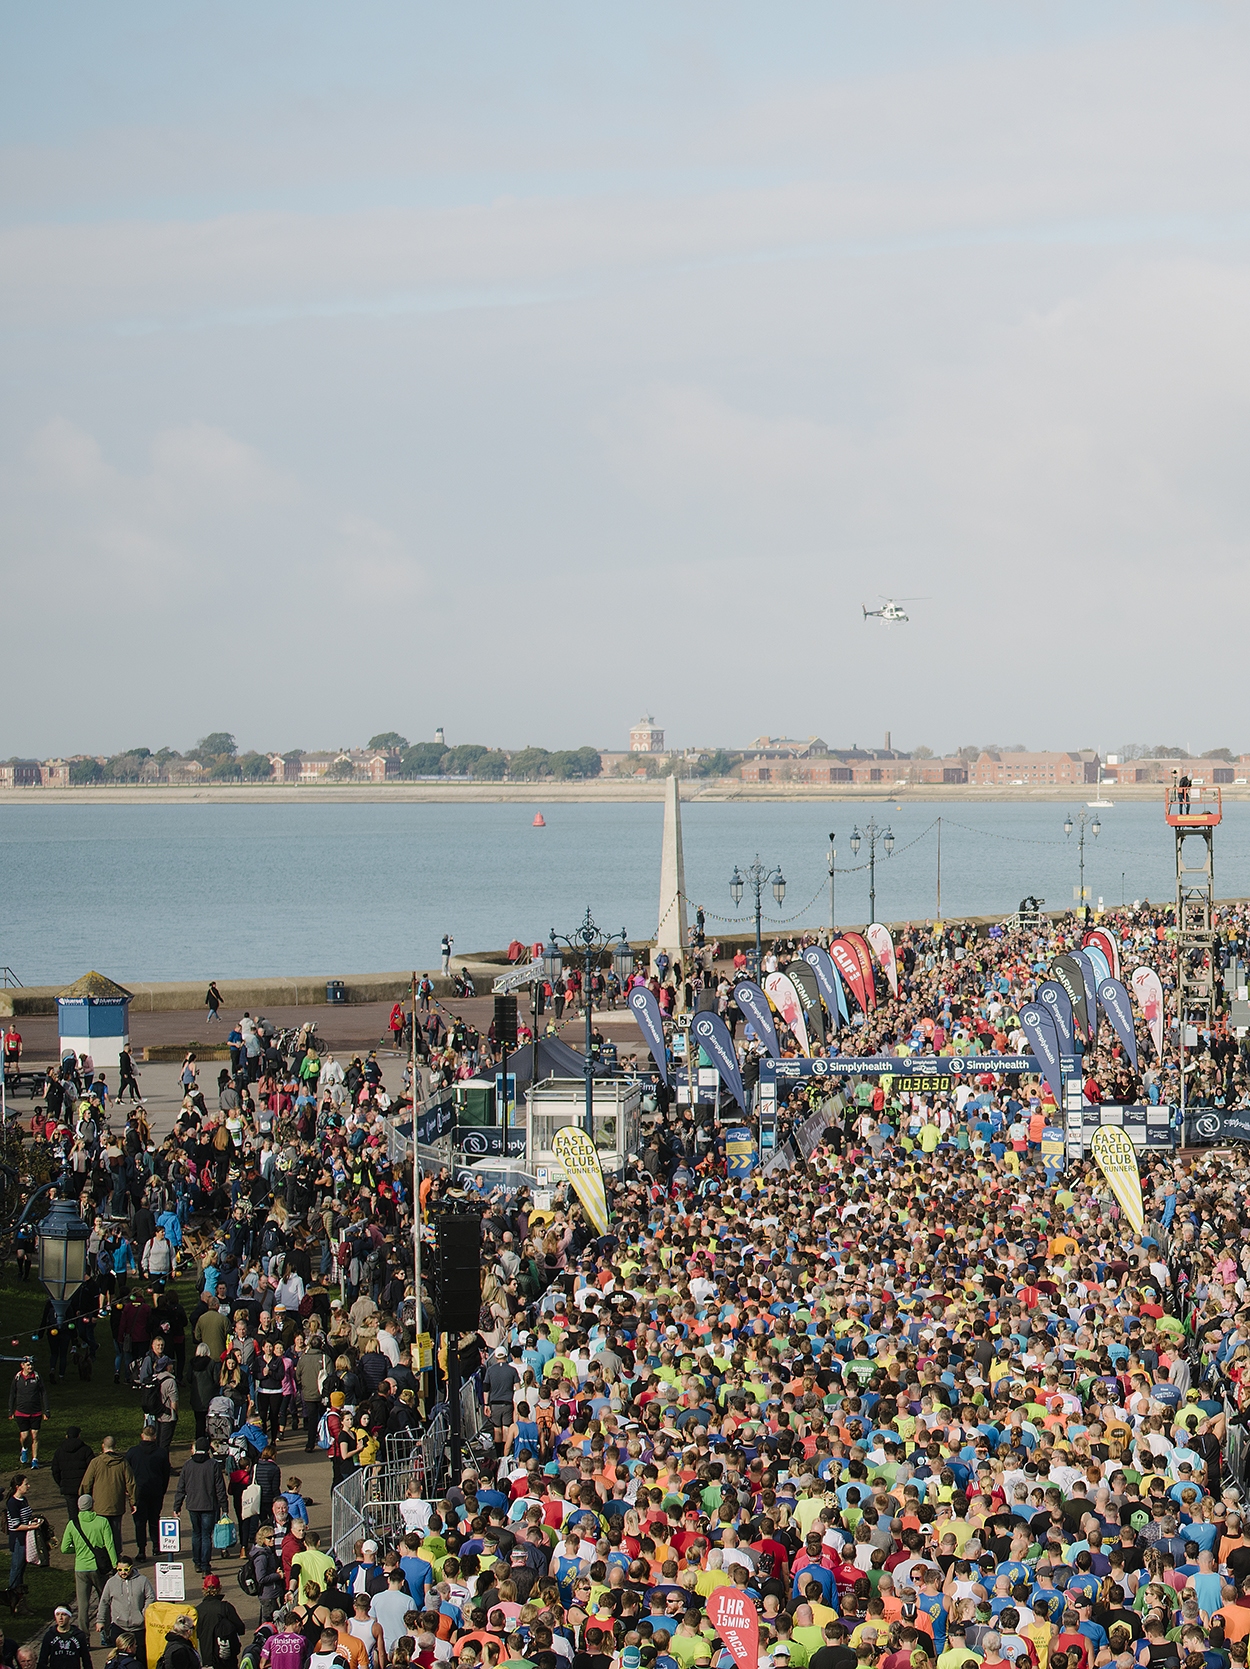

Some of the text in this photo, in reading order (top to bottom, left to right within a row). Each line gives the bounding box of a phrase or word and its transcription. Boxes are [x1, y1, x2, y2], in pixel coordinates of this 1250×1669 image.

[832, 945, 857, 975] CLIF
[816, 964, 833, 994] Simplyhealth
[1056, 967, 1078, 1006] GARMIN
[788, 971, 814, 1010] GARMIN
[642, 1008, 661, 1044] Simplyhealth
[749, 1001, 774, 1034] Simplyhealth
[1052, 1003, 1070, 1039] Simplyhealth
[1112, 1000, 1131, 1033] Simplyhealth
[709, 1034, 735, 1071] Simplyhealth
[1034, 1027, 1055, 1065] Simplyhealth
[830, 1062, 892, 1073] Simplyhealth
[966, 1060, 1030, 1072] Simplyhealth
[557, 1136, 585, 1146] FAST
[1096, 1133, 1122, 1144] FAST
[556, 1145, 594, 1156] PACED
[1094, 1144, 1131, 1154] PACED
[1102, 1154, 1132, 1164] CLUB
[564, 1156, 594, 1167] CLUB
[164, 1523, 175, 1536] P
[717, 1596, 745, 1616] 1HR
[716, 1614, 750, 1629] 15MINS
[275, 1644, 300, 1654] 2019
[725, 1630, 748, 1659] PACER
